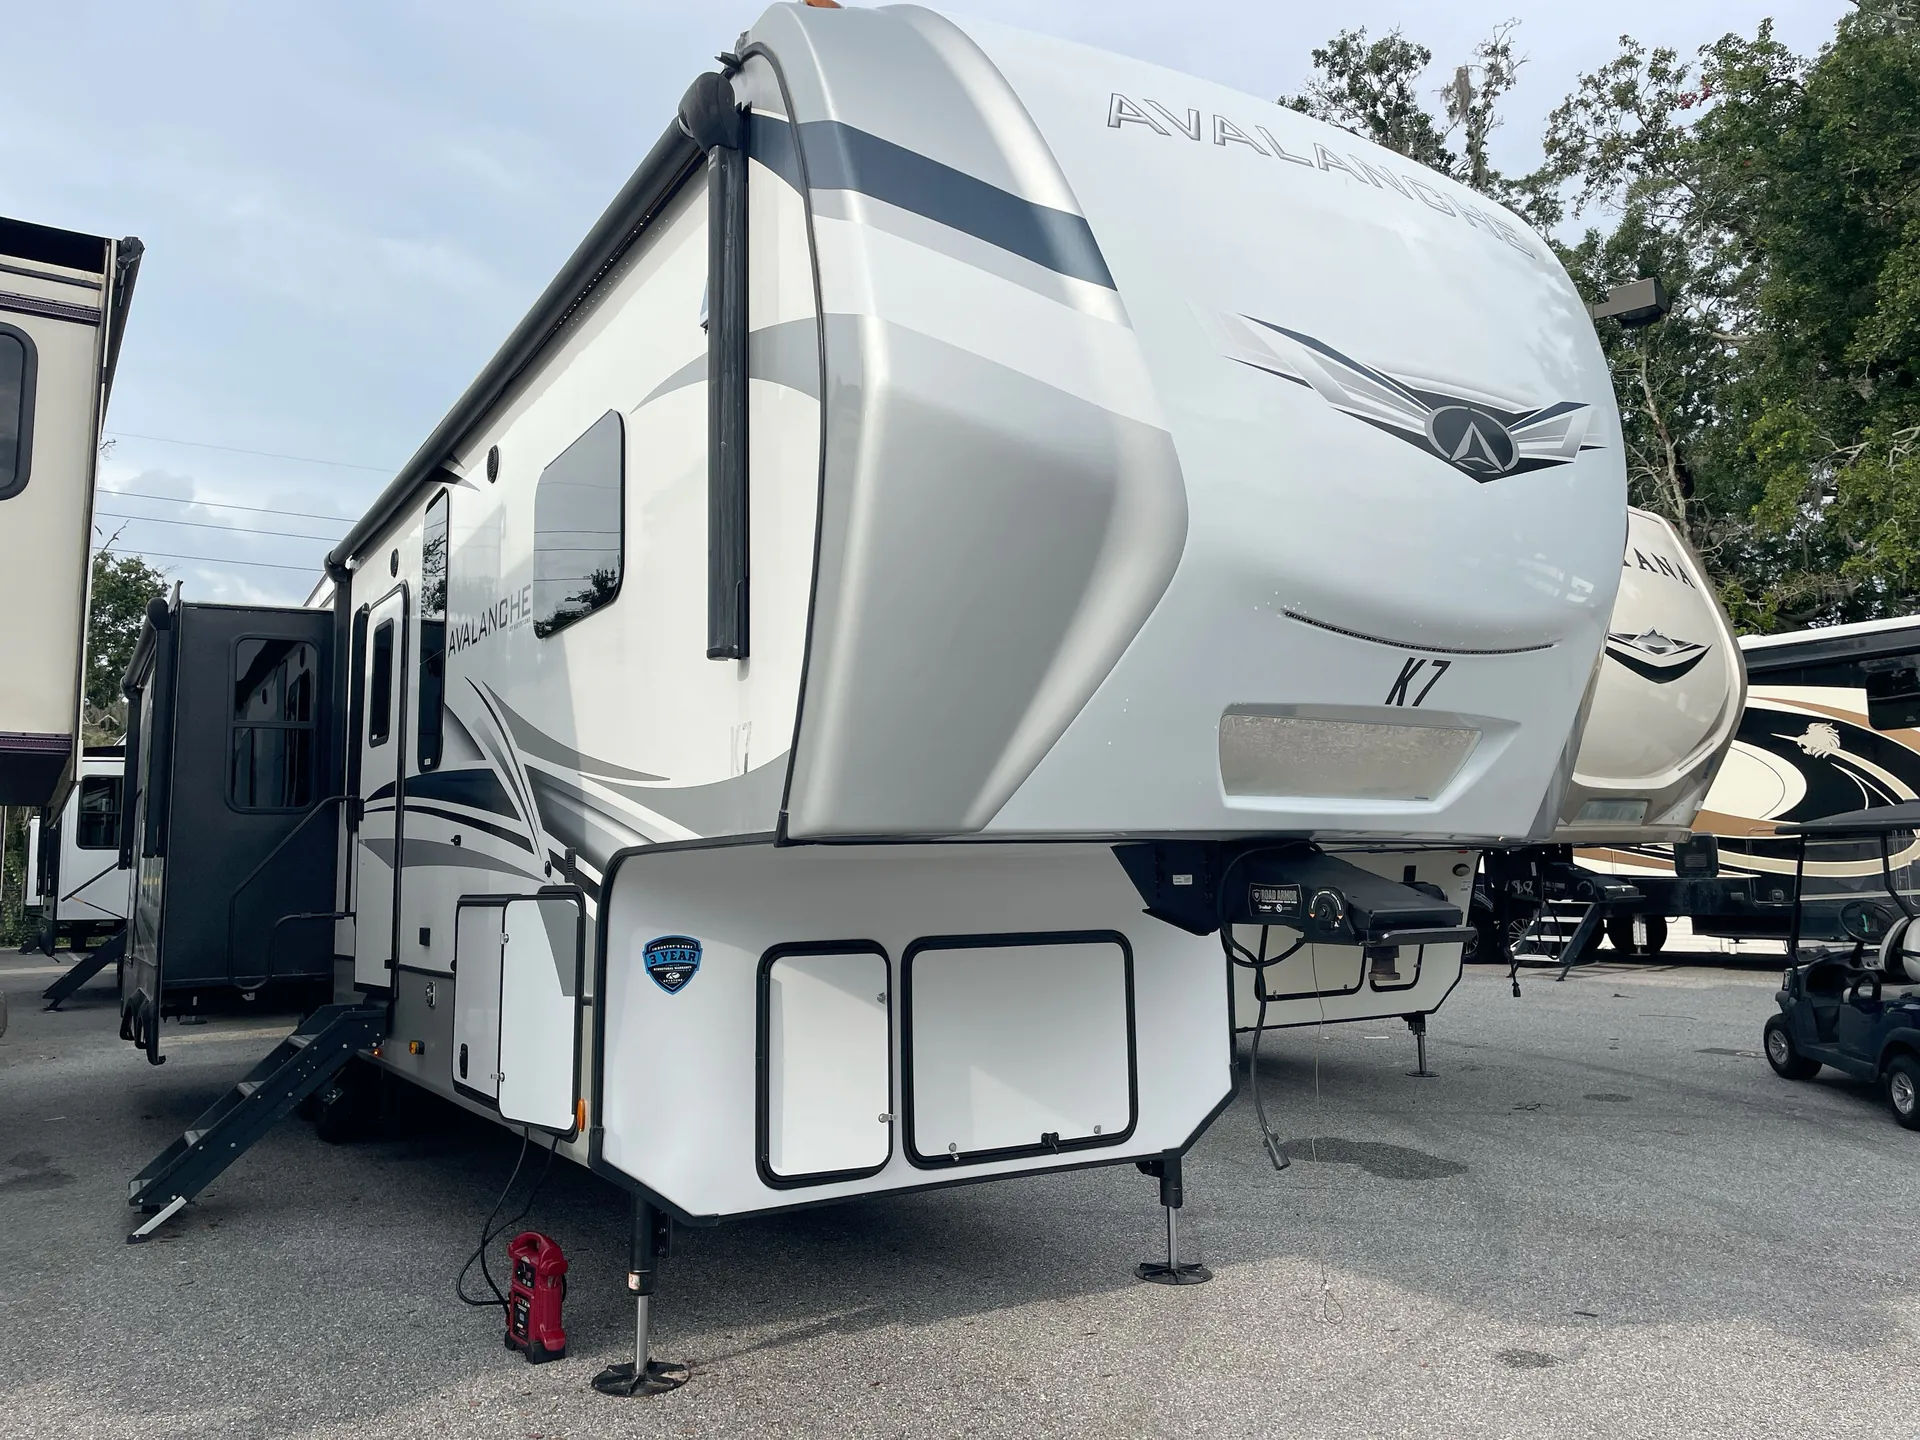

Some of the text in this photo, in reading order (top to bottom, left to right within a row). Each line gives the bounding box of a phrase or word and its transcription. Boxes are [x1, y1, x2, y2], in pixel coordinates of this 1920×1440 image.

[1107, 92, 1536, 259] AVALANCHE
[1623, 547, 1696, 589] ANA
[447, 583, 531, 658] AVALANCHE
[1385, 657, 1452, 707] K7
[649, 950, 696, 965] 3 YEAR
